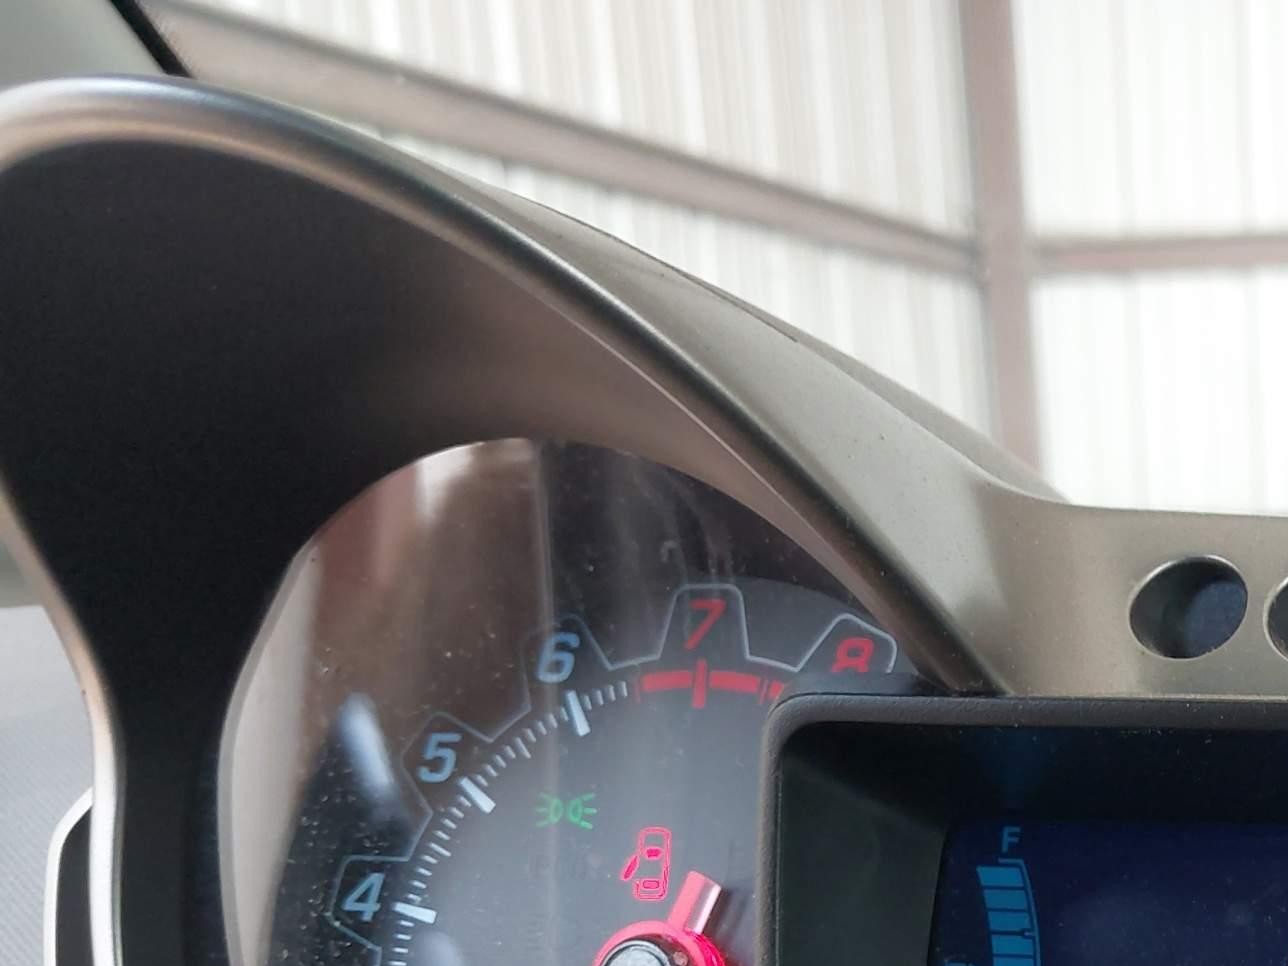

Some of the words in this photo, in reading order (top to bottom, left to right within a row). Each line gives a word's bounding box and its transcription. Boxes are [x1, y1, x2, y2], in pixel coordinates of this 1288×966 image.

[685, 598, 727, 651] 7
[537, 632, 581, 683] 6
[417, 732, 461, 783] 5
[1001, 827, 1021, 852] F
[343, 873, 382, 922] 4
